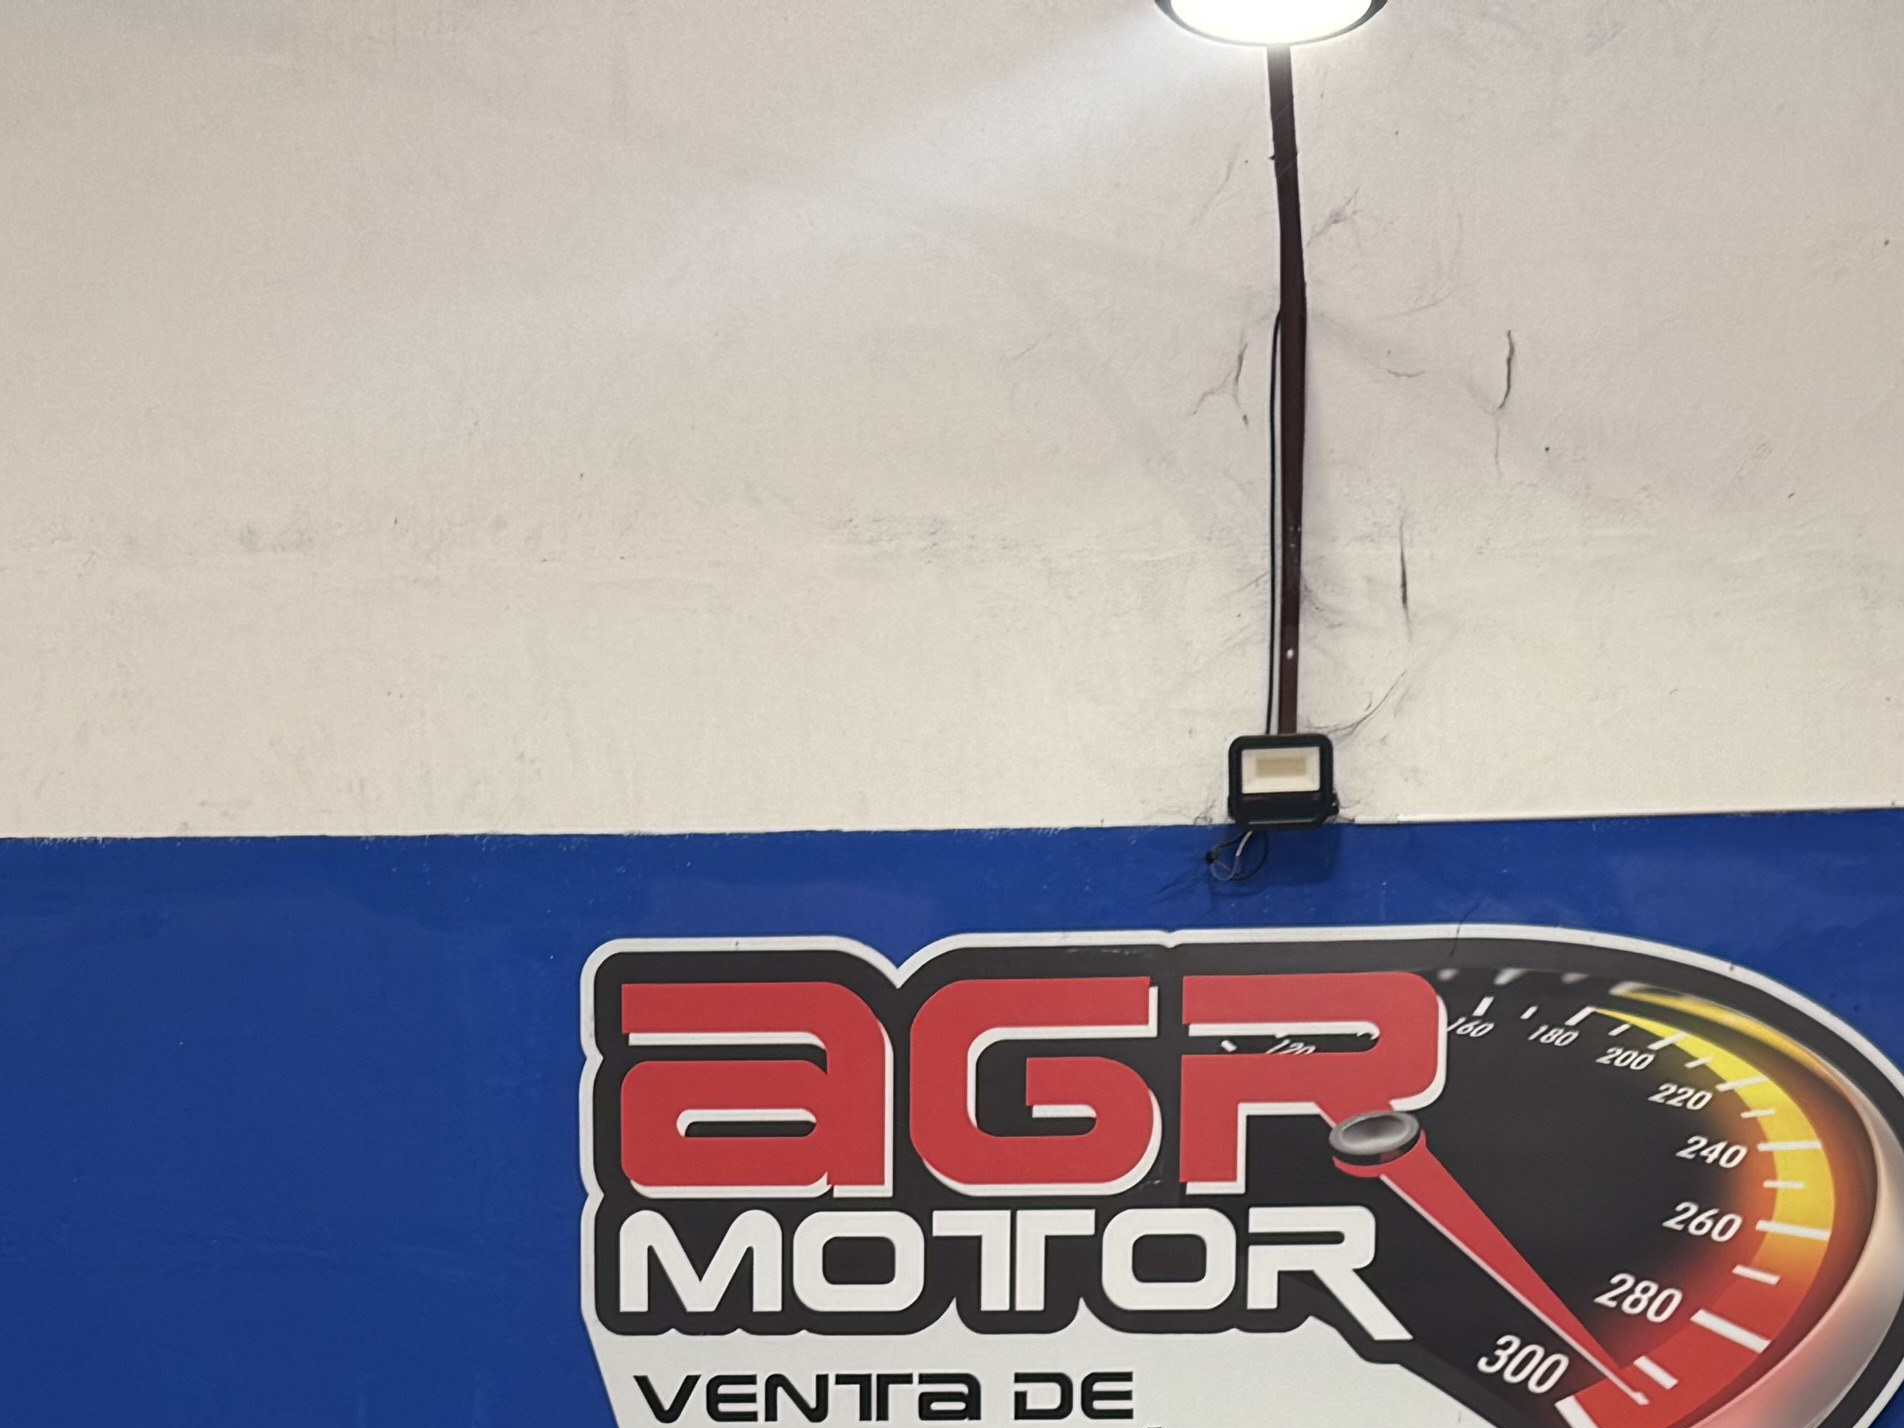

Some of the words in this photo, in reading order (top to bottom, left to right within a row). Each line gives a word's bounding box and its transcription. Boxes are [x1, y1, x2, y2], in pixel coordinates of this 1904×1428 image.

[1446, 1015, 1495, 1038] 160
[1528, 1023, 1579, 1048] 180
[1595, 1045, 1655, 1073] 200
[1647, 1083, 1713, 1113] 220
[1675, 1135, 1748, 1170] 240
[1662, 1201, 1742, 1244] 260
[619, 1204, 1414, 1342] MOTOR
[1593, 1272, 1684, 1325] 280
[1476, 1333, 1571, 1396] 300
[1012, 1370, 1135, 1421] DE
